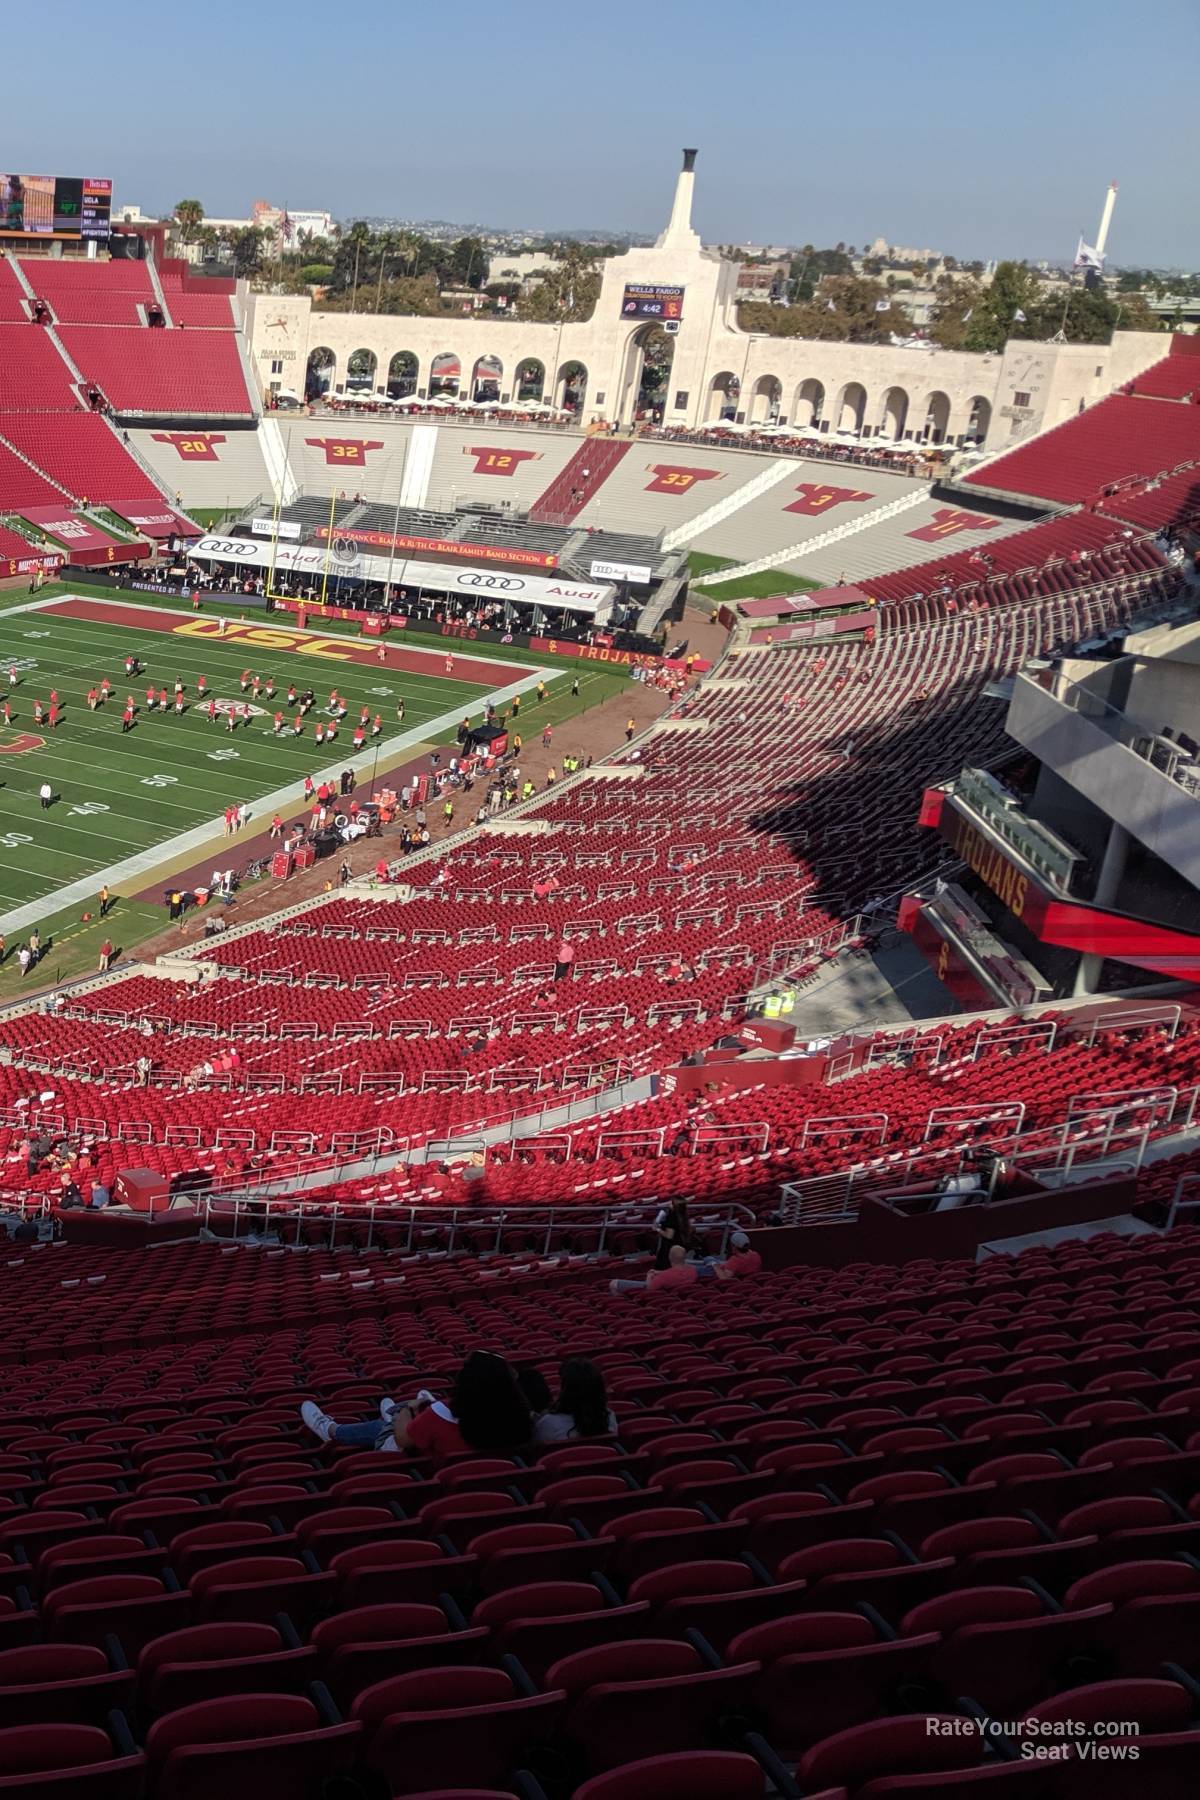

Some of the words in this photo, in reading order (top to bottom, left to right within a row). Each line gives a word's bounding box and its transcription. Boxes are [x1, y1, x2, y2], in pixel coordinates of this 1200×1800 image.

[629, 286, 654, 294] WELLS
[655, 287, 681, 295] FARGO
[642, 303, 661, 313] 4:42
[179, 441, 208, 453] 20
[331, 445, 359, 458] 32
[485, 454, 512, 468] 12
[661, 473, 694, 487] 33
[809, 494, 832, 507] 3
[38, 518, 88, 532] MUSCLE
[58, 528, 93, 539] MILK
[277, 551, 324, 563] Audi
[407, 540, 428, 549] RUTH
[437, 543, 458, 553] BLAIR
[460, 544, 486, 556] FAMILY
[486, 550, 508, 559] BAND
[508, 553, 541, 563] SECTION
[43, 555, 60, 568] MILK
[131, 581, 167, 594] PRESENTED
[168, 586, 176, 594] BY
[546, 586, 600, 600] Audi
[172, 618, 378, 660] USC
[441, 625, 478, 640] UTES
[578, 644, 657, 666] TROJANS
[140, 774, 179, 787] 50
[72, 801, 110, 815] 40
[955, 816, 1029, 917] TROJANS
